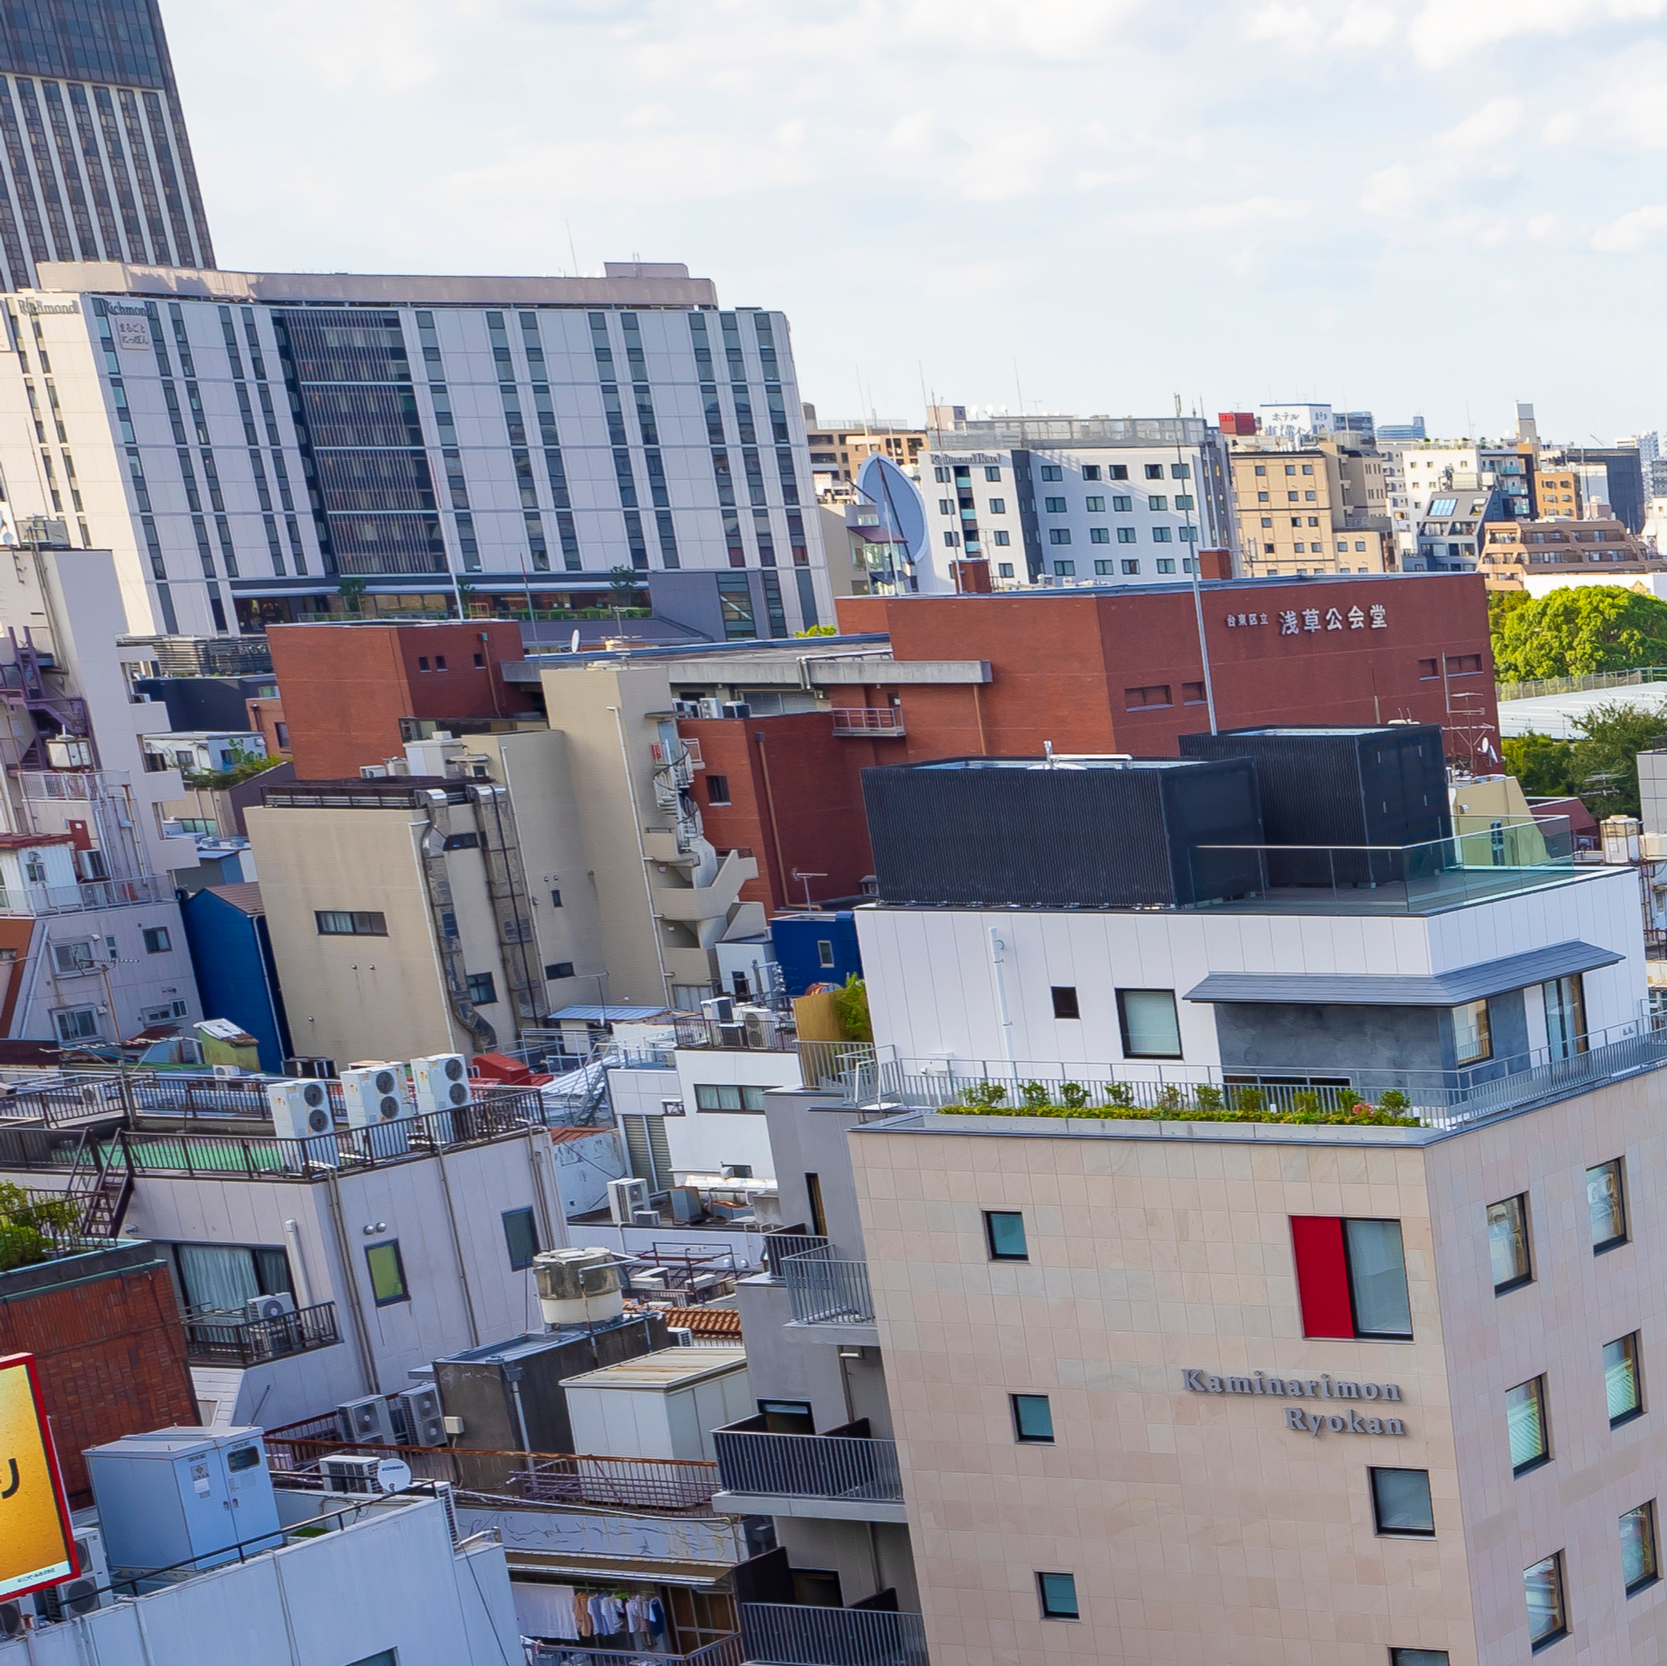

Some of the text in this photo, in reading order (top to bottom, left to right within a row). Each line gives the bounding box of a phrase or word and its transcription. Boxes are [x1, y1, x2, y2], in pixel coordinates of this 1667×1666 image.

[1226, 603, 1388, 636] 台東区立 浅草公会堂
[1180, 1367, 1401, 1402] Kaminarimon
[1284, 1406, 1405, 1439] Ryokan
